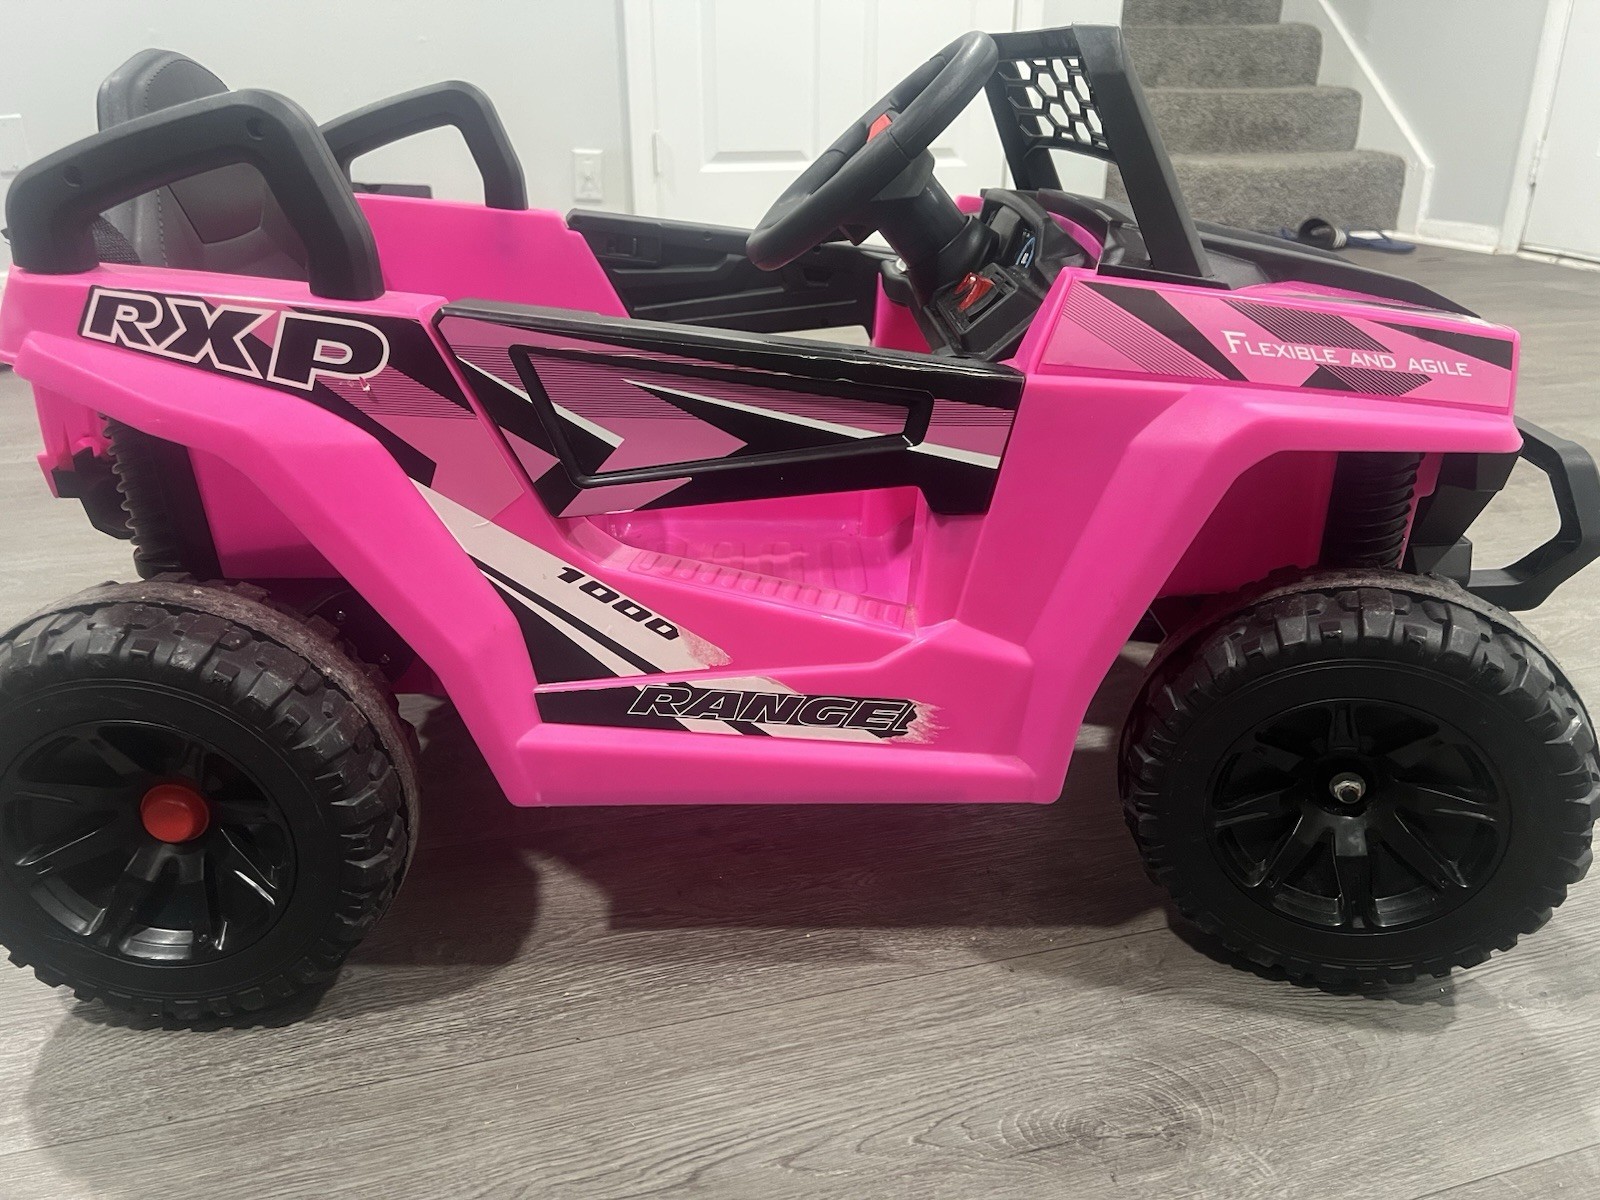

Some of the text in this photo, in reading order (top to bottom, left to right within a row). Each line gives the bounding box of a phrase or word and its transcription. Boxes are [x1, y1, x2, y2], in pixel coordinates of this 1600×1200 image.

[82, 288, 390, 391] RXP
[1221, 330, 1472, 377] FLEXIBLE AND AGILE
[557, 567, 680, 641] 1000
